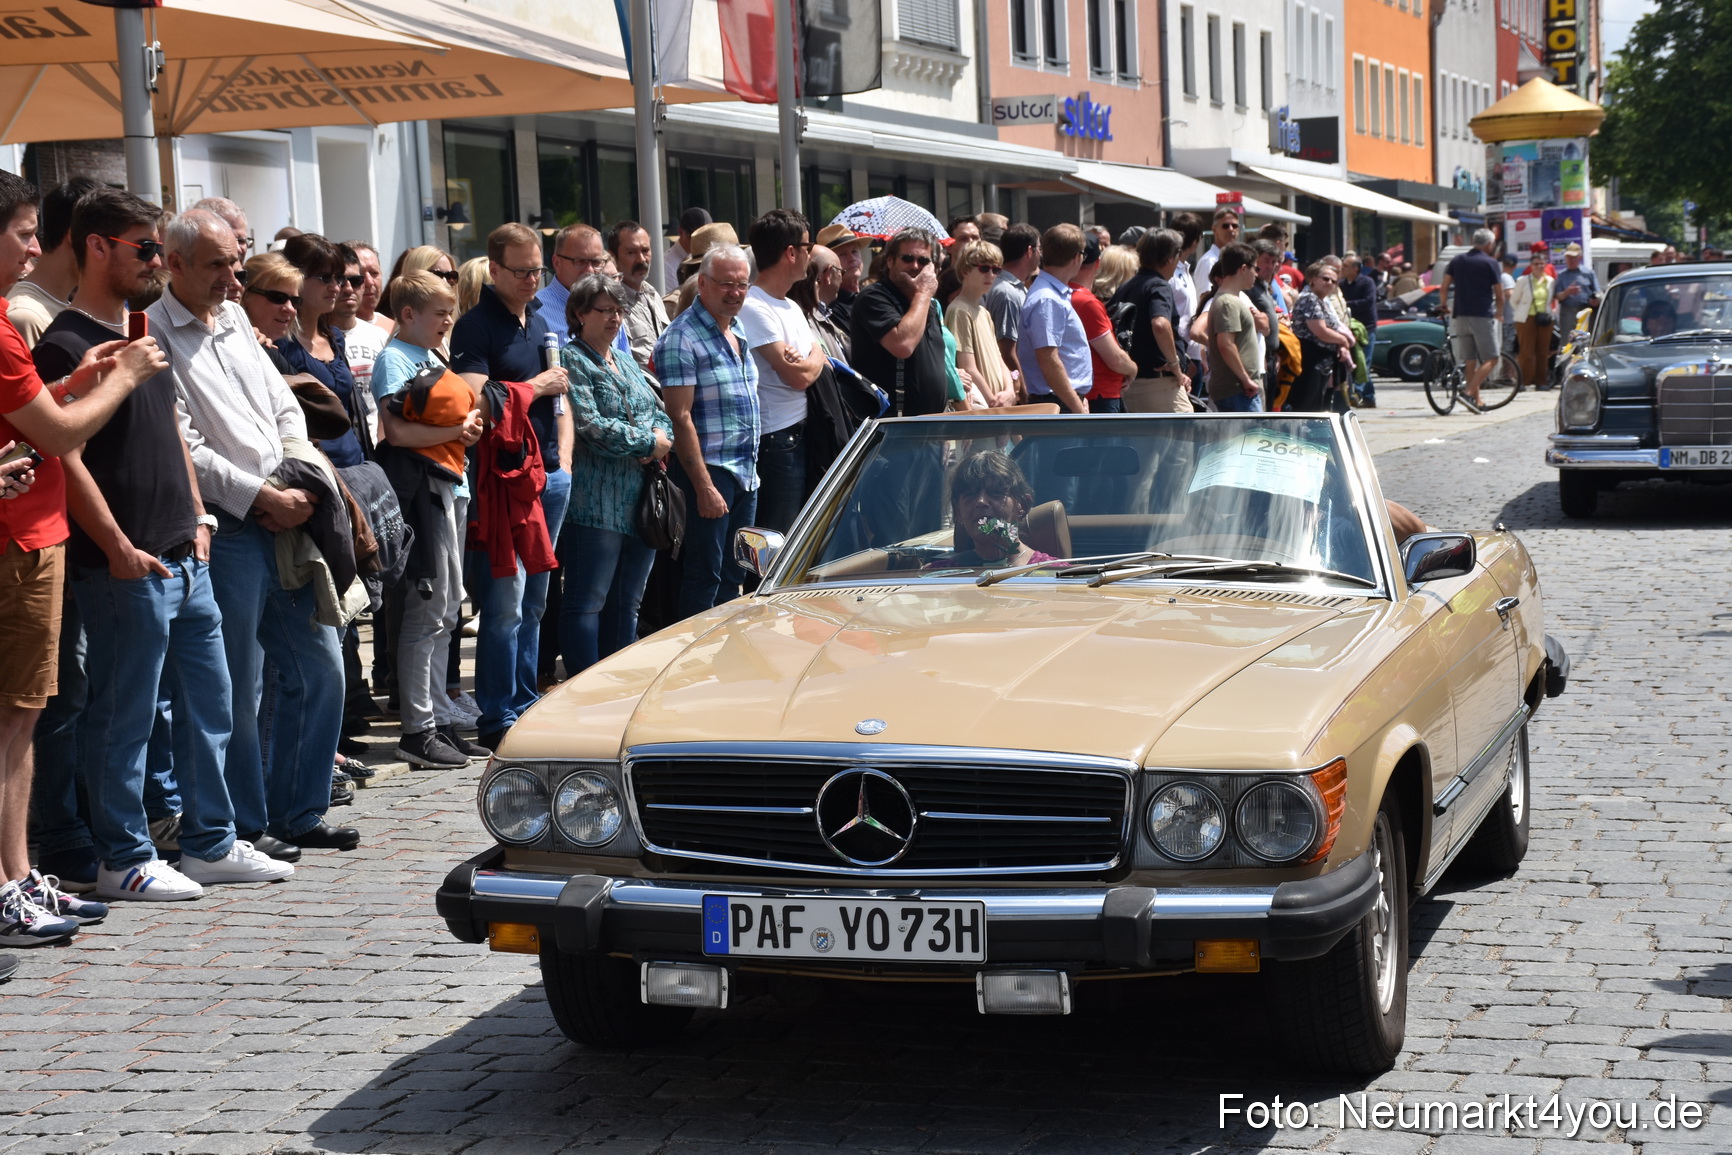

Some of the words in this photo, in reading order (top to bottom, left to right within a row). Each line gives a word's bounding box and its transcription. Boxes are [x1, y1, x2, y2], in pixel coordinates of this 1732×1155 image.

[1257, 439, 1303, 457] 264
[1670, 450, 1688, 465] NM
[1699, 450, 1718, 465] DB
[1721, 450, 1732, 465] 2
[730, 903, 806, 949] PAF
[712, 931, 722, 944] D
